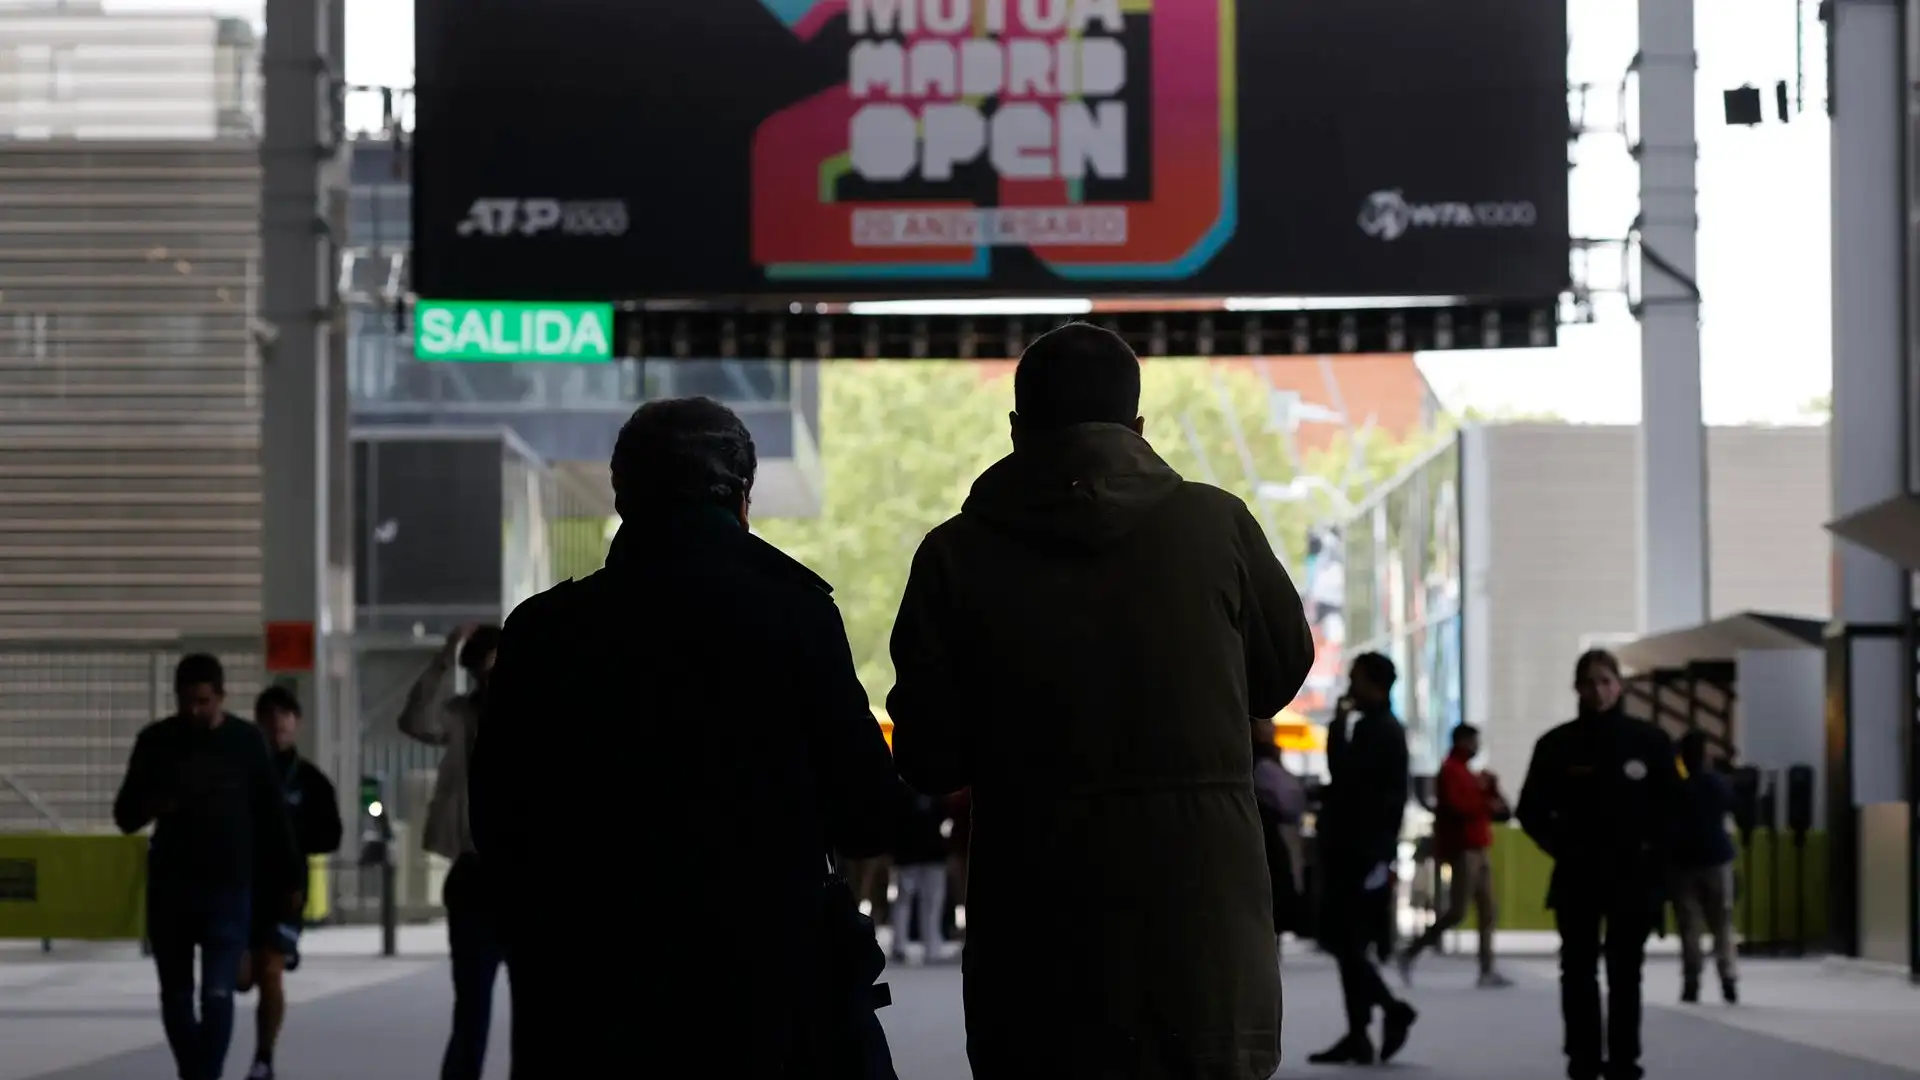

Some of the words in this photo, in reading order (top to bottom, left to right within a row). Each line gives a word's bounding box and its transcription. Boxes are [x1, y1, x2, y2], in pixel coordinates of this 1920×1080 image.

[848, 37, 1126, 97] MADRID
[849, 101, 1126, 181] OPEN
[457, 198, 562, 237] ATP
[420, 308, 608, 355] SALIDA
